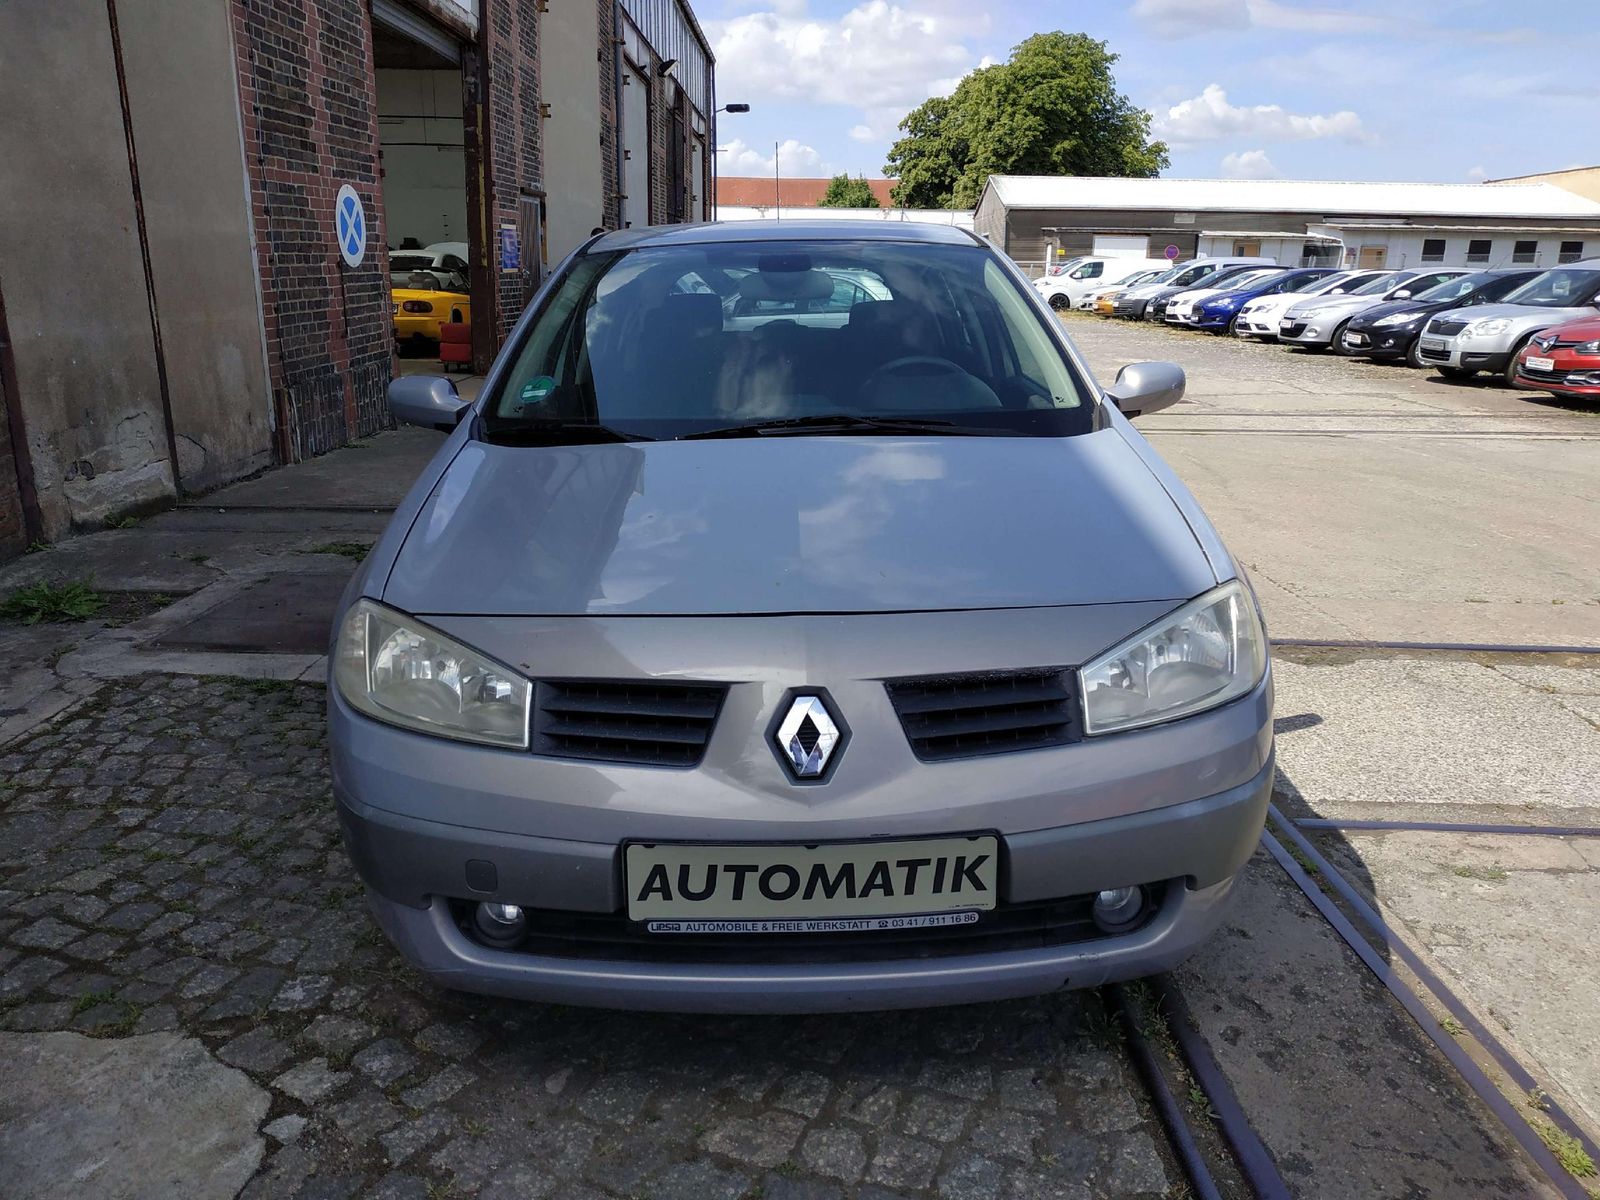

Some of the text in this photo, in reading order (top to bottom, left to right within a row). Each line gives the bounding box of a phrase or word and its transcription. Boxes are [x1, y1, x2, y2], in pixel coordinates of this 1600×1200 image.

[636, 855, 990, 902] AUTOMATIK
[686, 922, 758, 932] AUTOMOBILE
[761, 922, 769, 931] &
[772, 922, 802, 931] FREIE
[806, 920, 872, 931] WERKSTATT
[892, 919, 904, 928] 03
[907, 918, 919, 927] 41
[928, 915, 947, 925] 911
